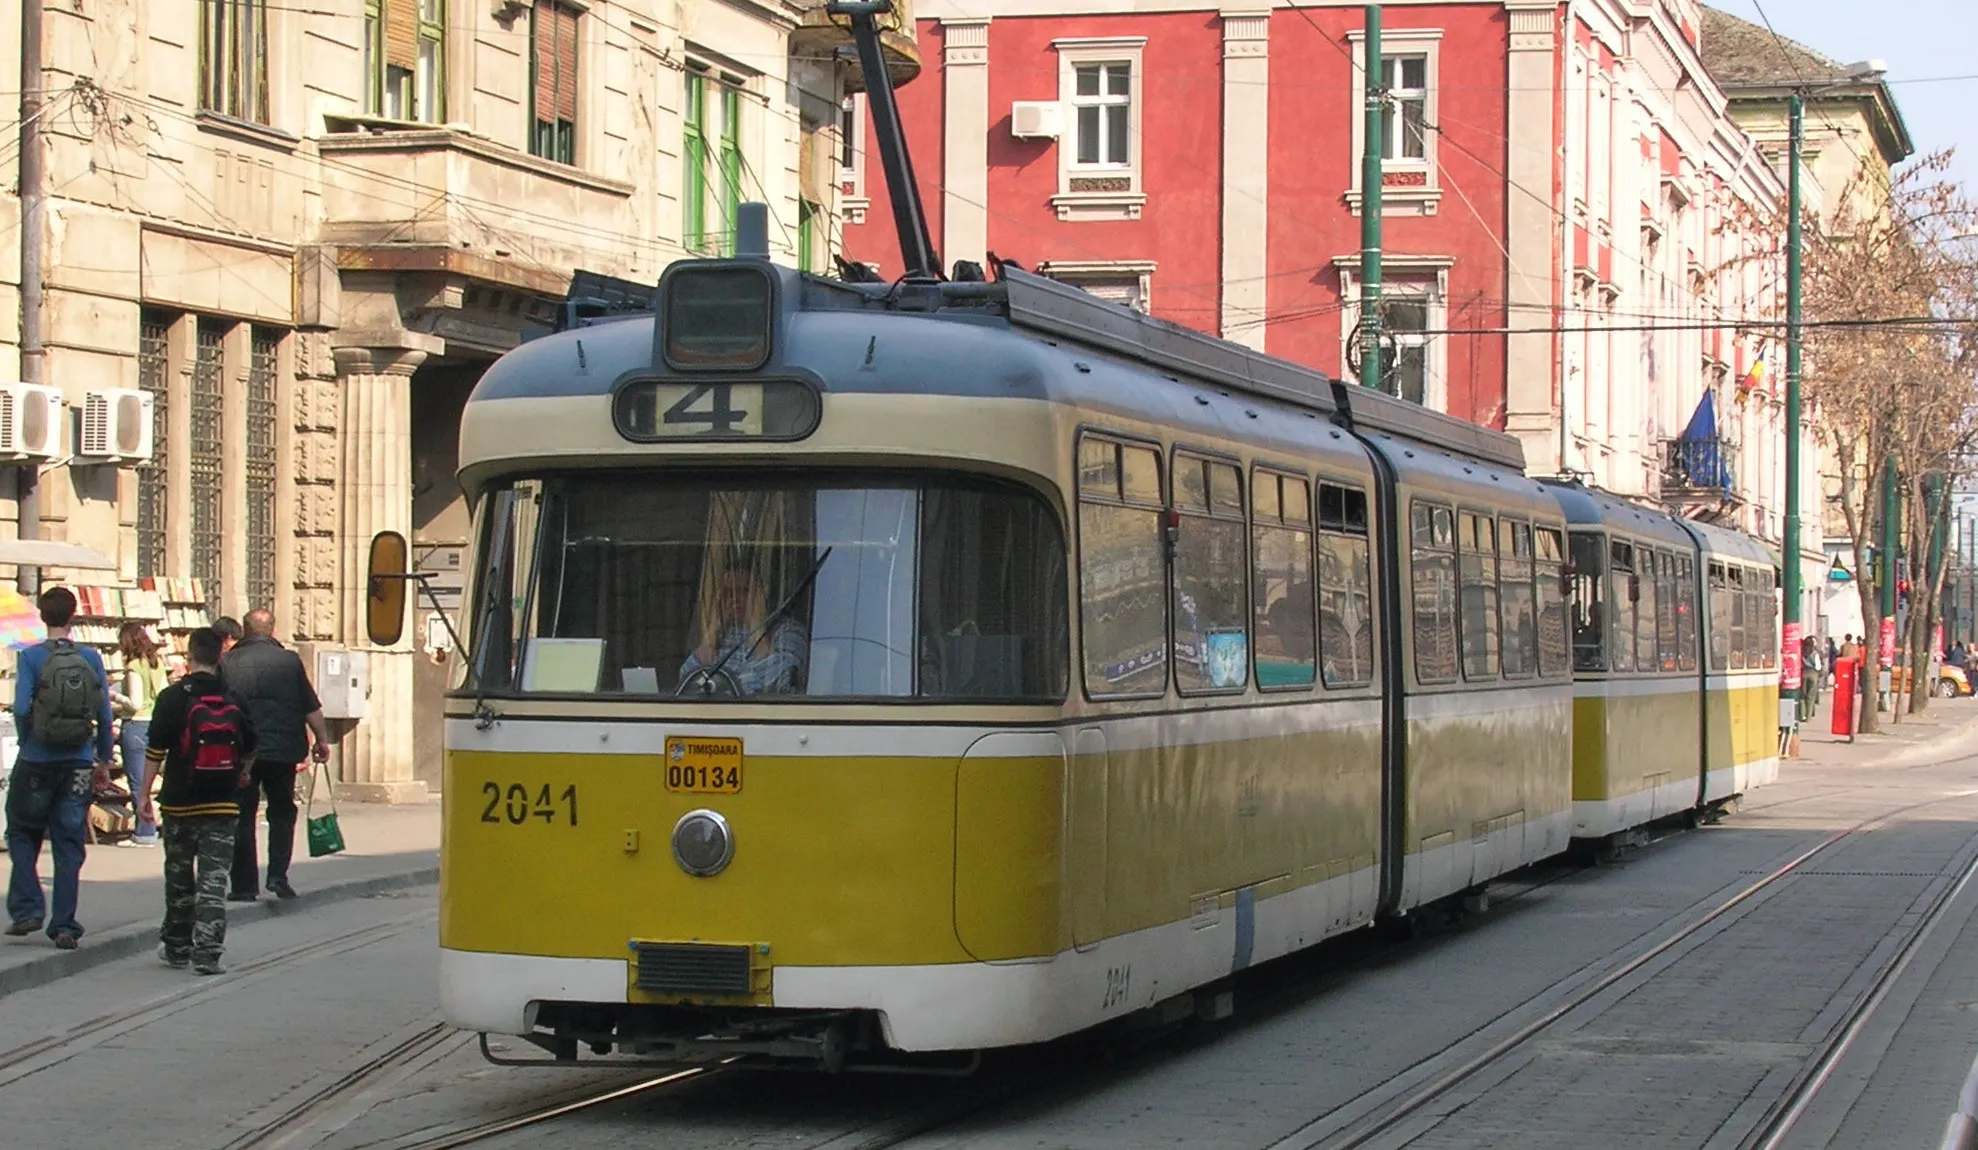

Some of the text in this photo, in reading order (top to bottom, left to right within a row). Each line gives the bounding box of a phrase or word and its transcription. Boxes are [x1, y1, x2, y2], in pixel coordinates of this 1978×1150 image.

[663, 383, 748, 434] 4
[669, 765, 739, 788] 00134
[481, 781, 577, 826] 2041
